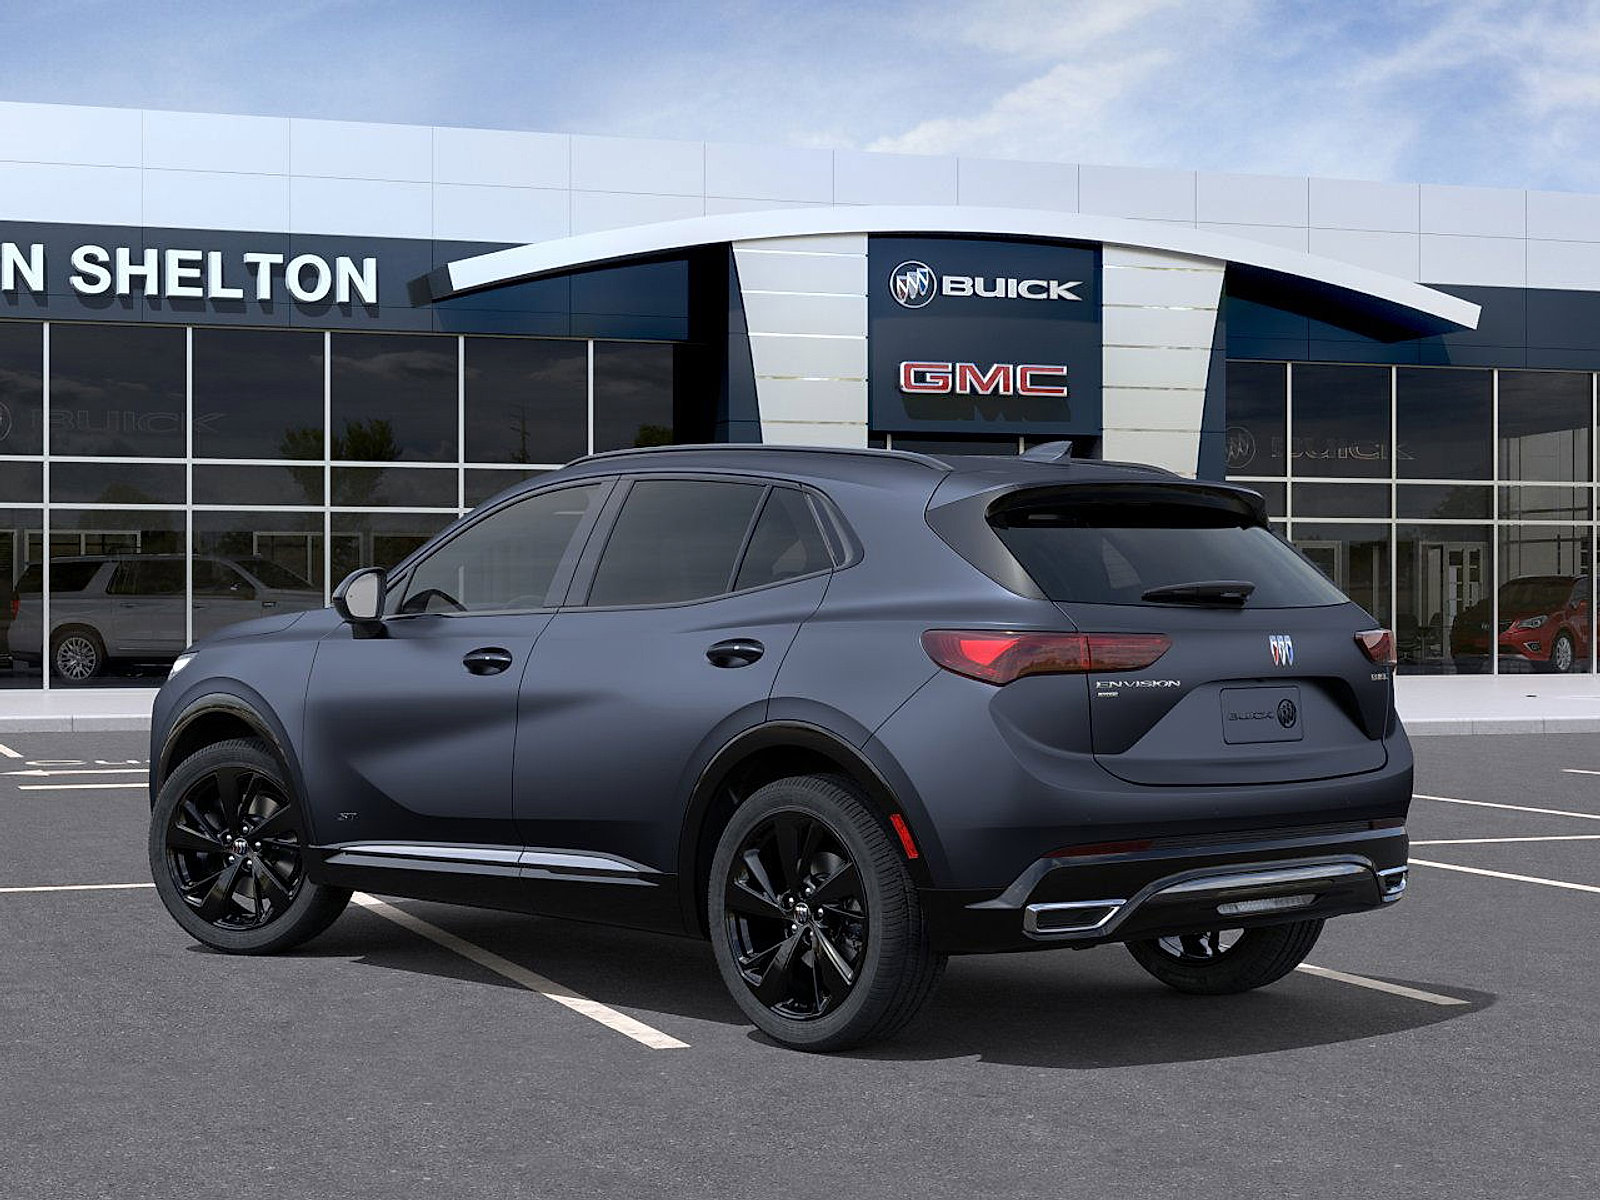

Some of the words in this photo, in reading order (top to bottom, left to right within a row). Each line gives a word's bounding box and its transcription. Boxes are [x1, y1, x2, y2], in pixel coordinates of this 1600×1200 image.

[69, 244, 378, 304] SHELTON
[942, 274, 1083, 301] BUICK
[900, 360, 1068, 398] GMC
[1096, 680, 1181, 689] ENVISION
